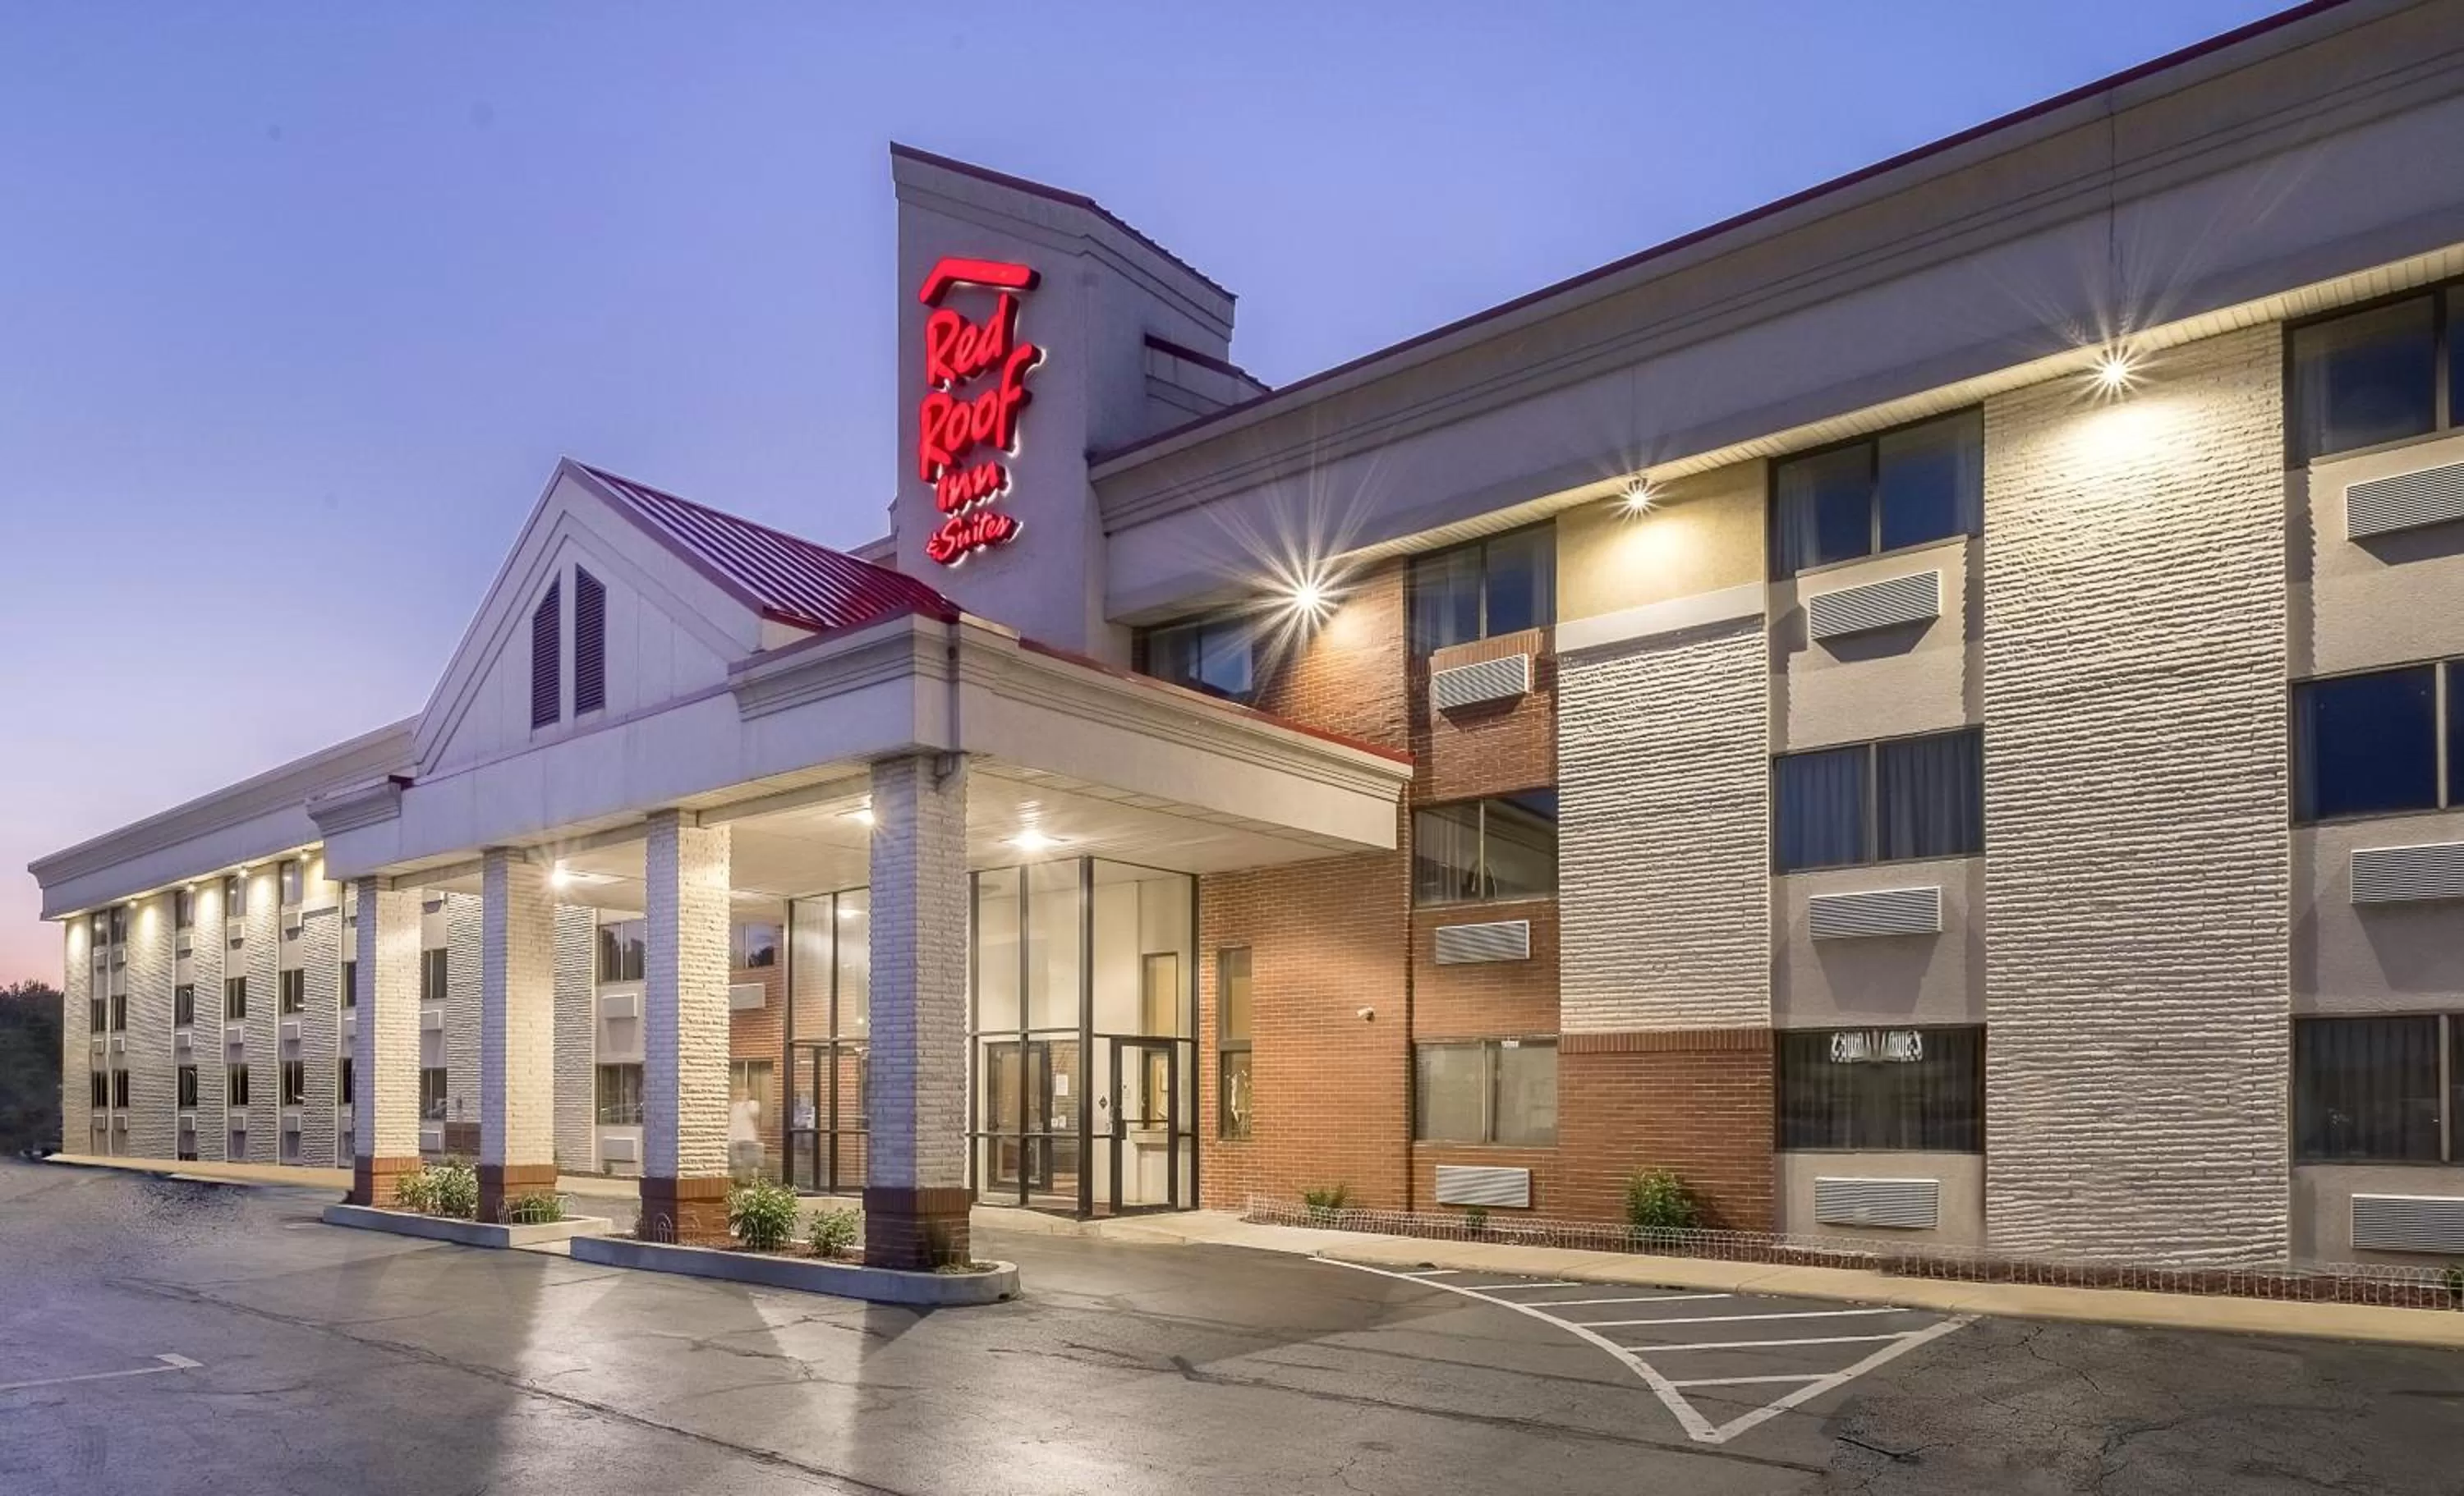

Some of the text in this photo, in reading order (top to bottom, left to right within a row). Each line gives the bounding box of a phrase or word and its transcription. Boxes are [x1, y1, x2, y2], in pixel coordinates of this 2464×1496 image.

[926, 292, 1012, 387] Red
[919, 342, 1035, 484] Roof
[936, 460, 1001, 513] Inn
